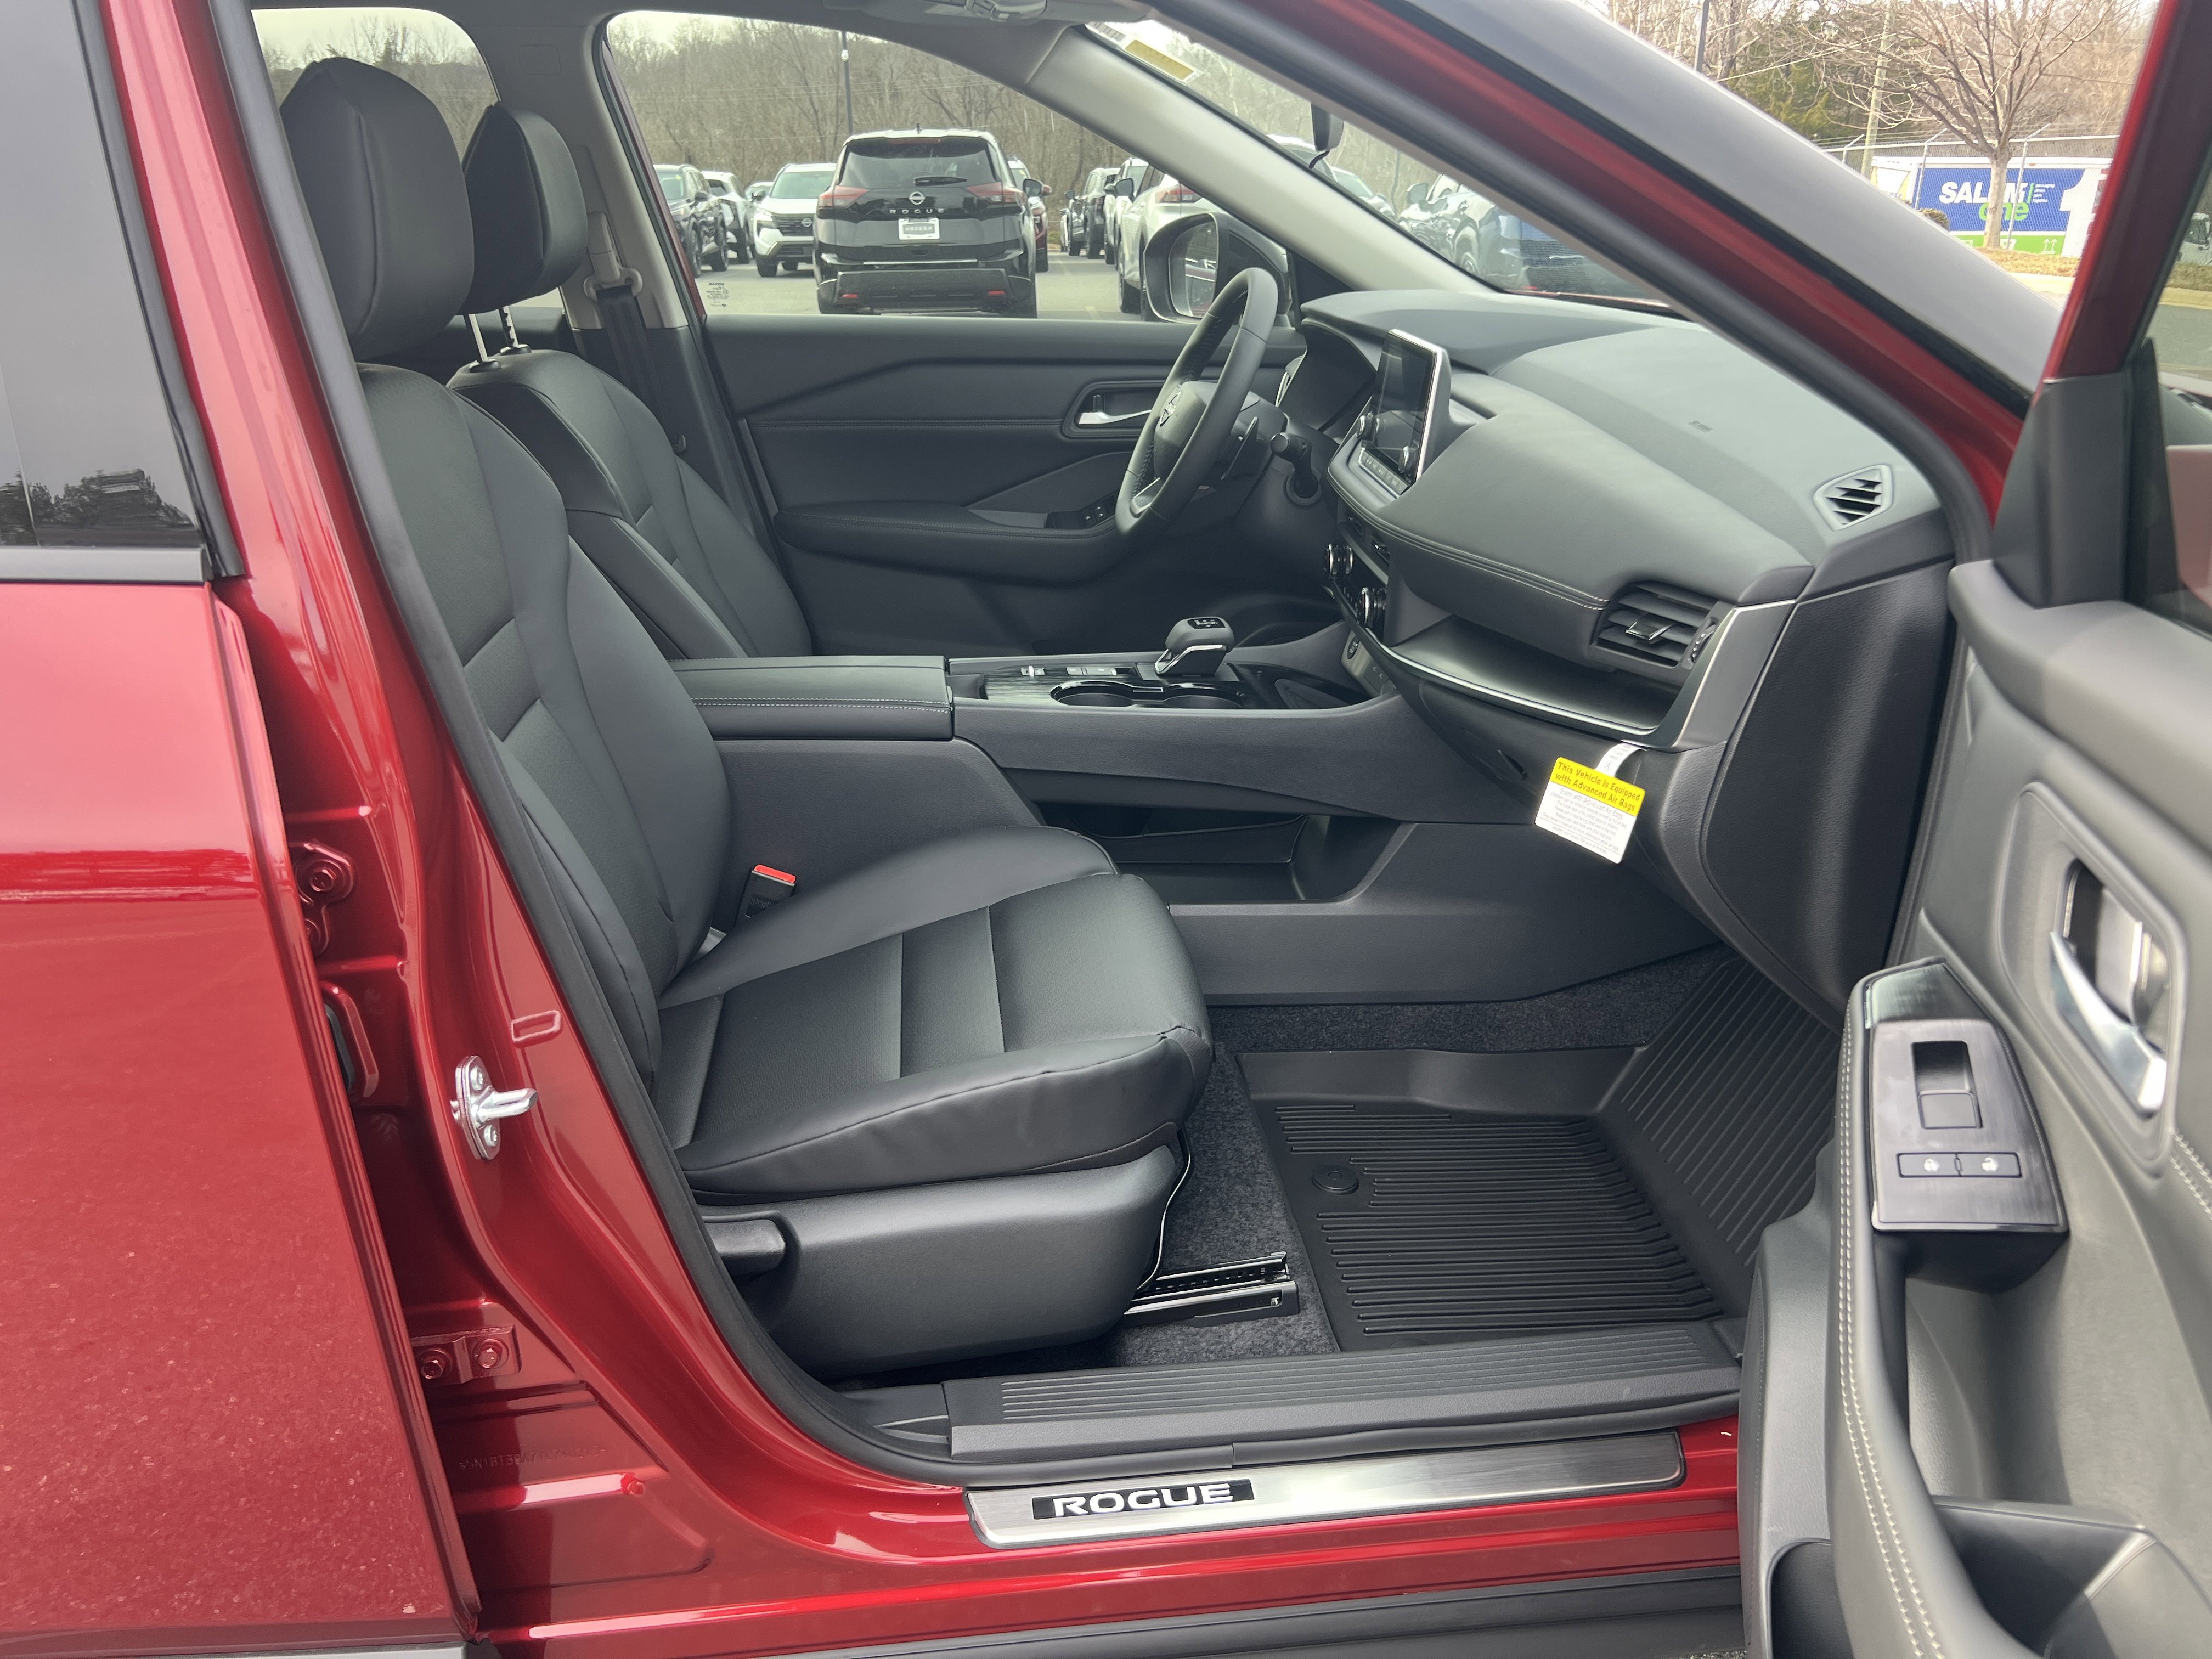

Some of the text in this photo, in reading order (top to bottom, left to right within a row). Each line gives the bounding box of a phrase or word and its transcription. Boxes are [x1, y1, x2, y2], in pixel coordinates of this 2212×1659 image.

[1939, 181, 2028, 204] SALM
[1555, 773, 1635, 812] with Advanced Air Bags
[1558, 761, 1641, 802] This Vehicle is Equipped
[1053, 1483, 1233, 1517] ROGUE
